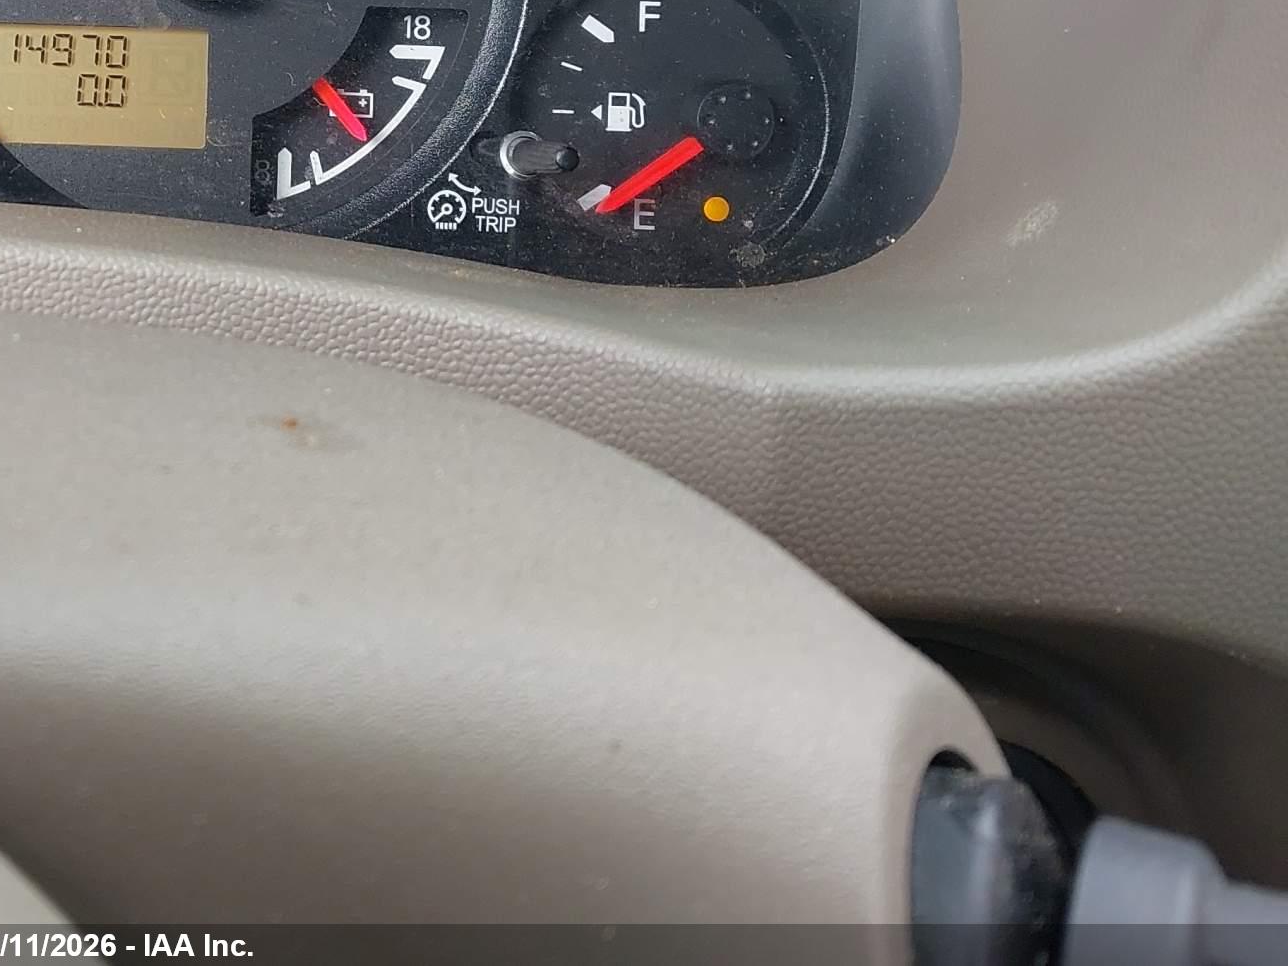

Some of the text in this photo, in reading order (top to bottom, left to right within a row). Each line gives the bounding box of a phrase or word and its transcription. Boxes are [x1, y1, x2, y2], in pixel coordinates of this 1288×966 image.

[405, 15, 431, 39] 18
[639, 1, 661, 32] F
[77, 75, 125, 107] 0.0
[473, 197, 520, 215] PUSH
[634, 199, 655, 230] E
[475, 215, 516, 233] TRIP
